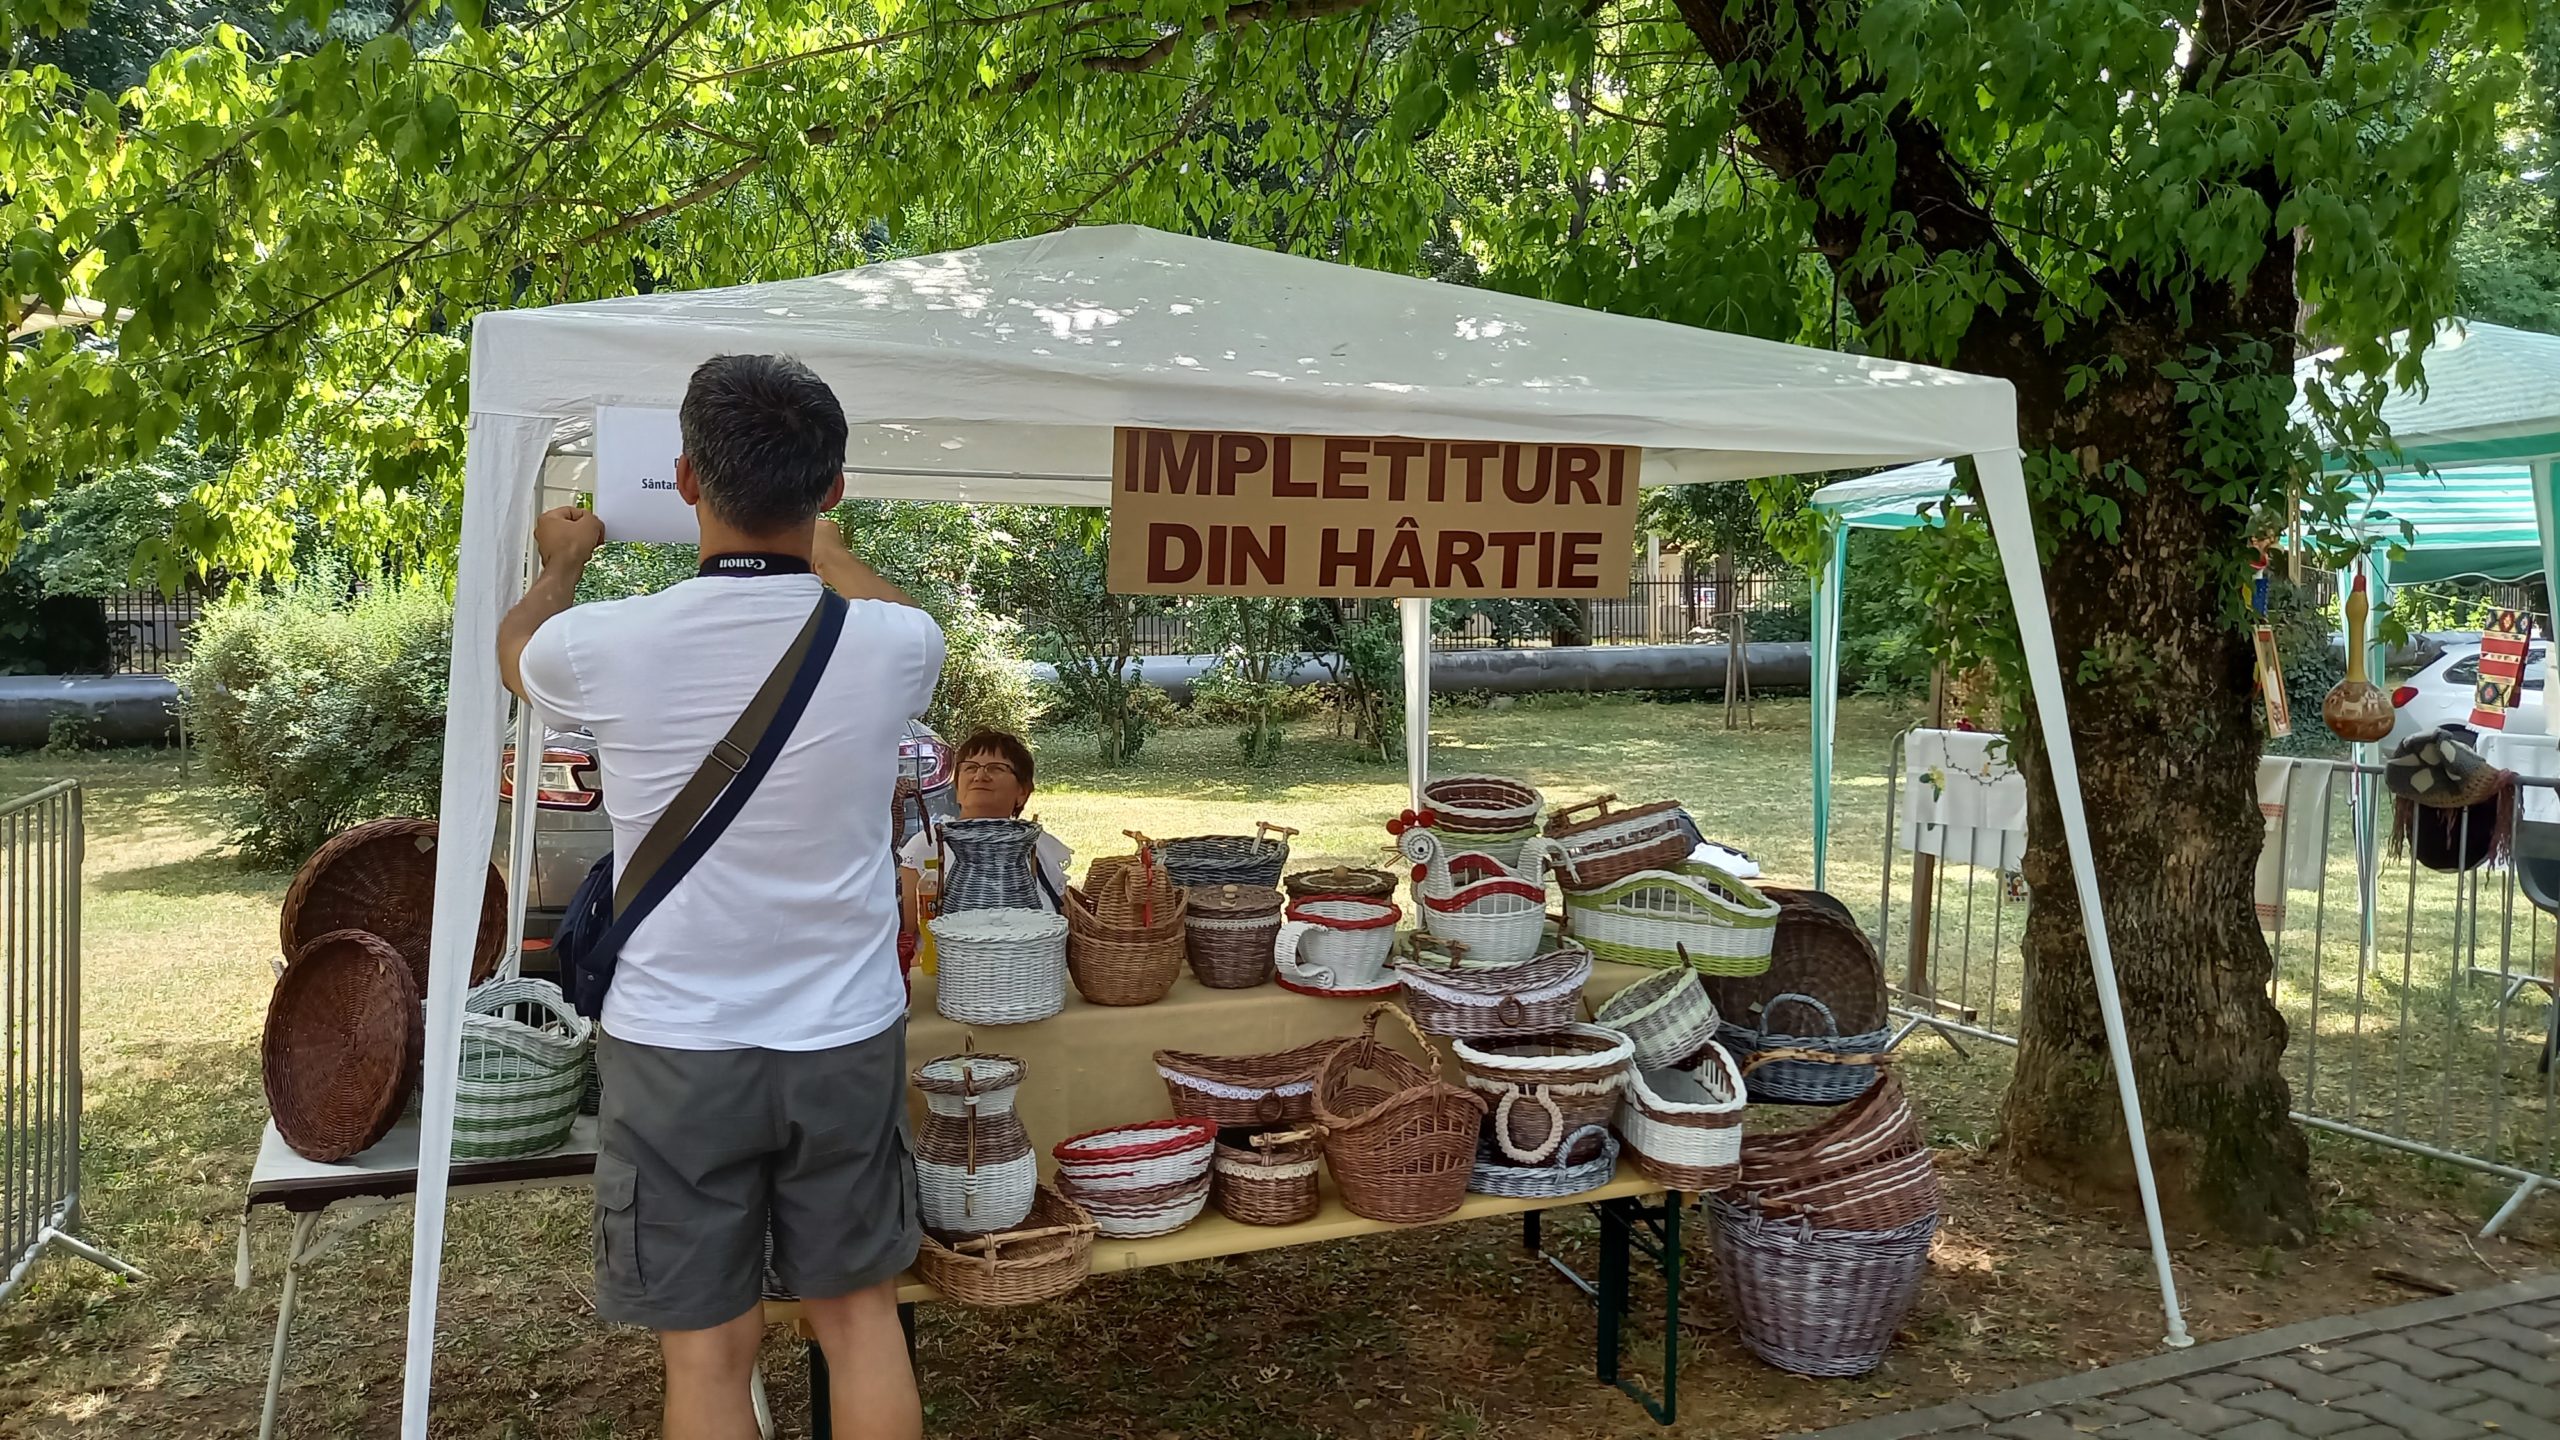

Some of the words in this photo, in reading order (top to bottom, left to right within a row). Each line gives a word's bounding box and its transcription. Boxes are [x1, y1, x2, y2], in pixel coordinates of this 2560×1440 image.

[1124, 430, 1624, 506] IMPLETITURI
[719, 558, 766, 570] Canon
[1147, 522, 1287, 586] DIN
[1318, 516, 1602, 588] HÂRTIE
